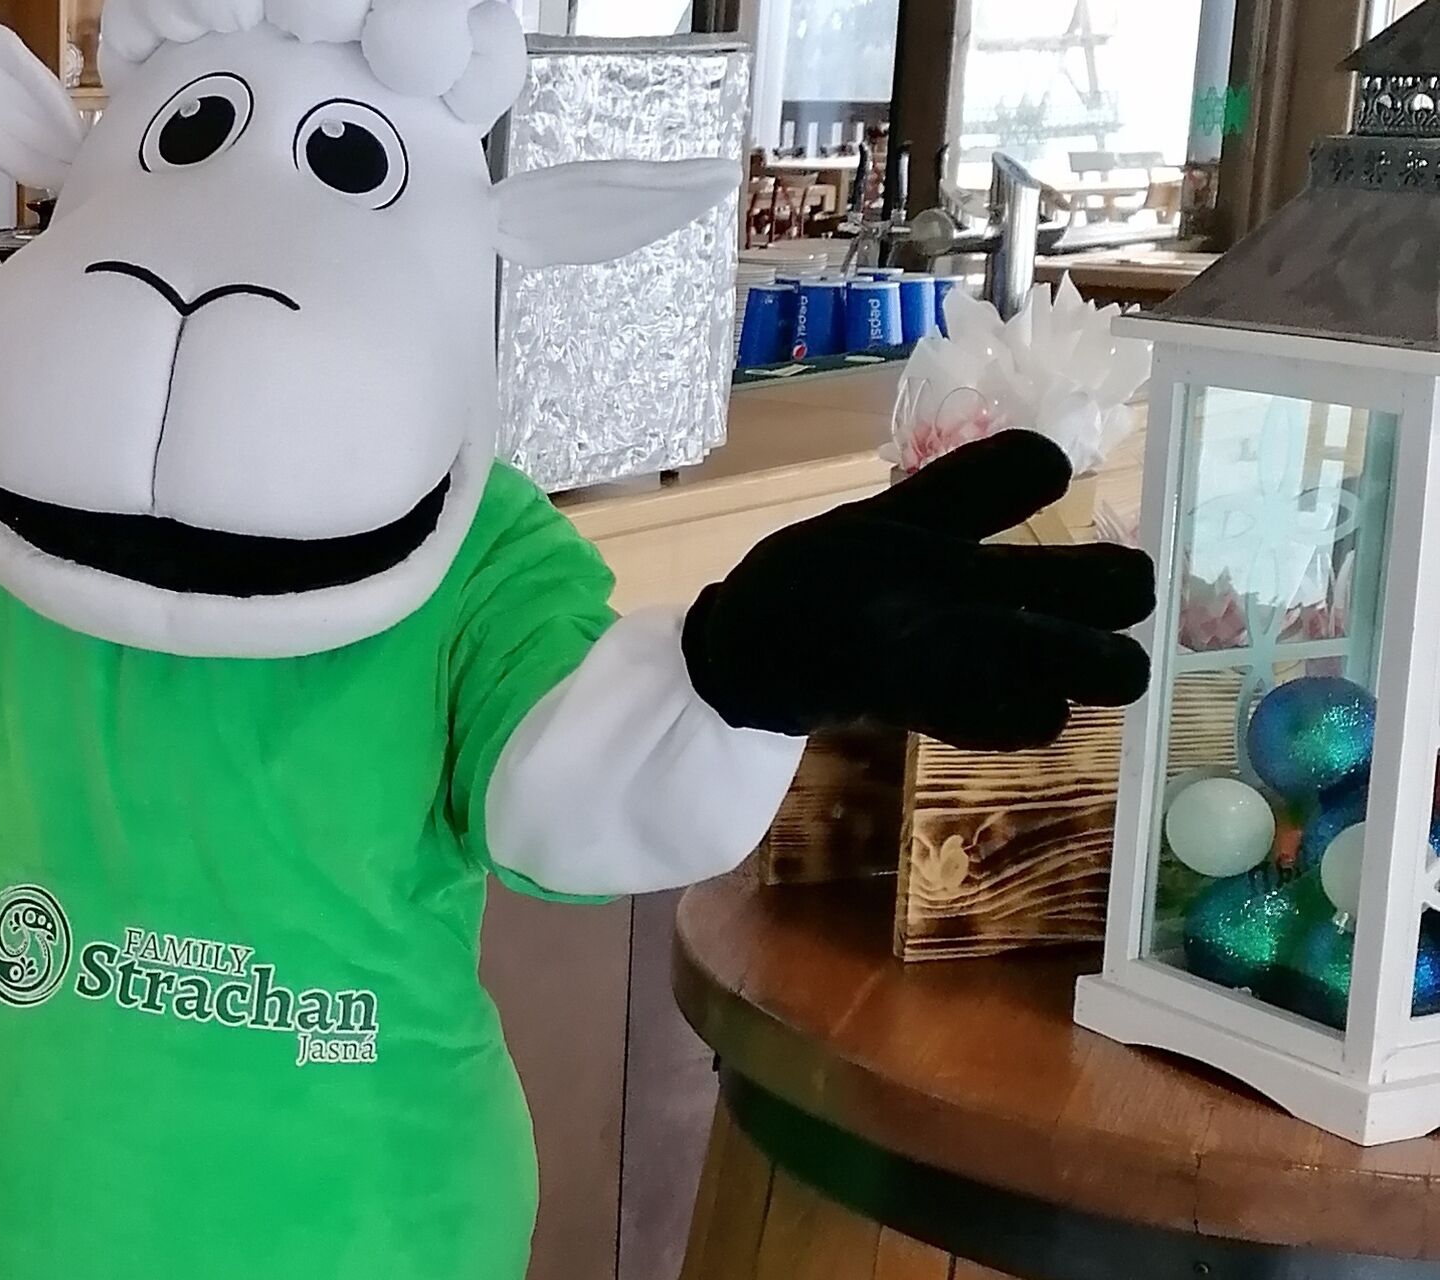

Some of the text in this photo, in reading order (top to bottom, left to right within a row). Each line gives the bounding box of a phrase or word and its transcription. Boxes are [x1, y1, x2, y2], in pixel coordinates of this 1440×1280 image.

[868, 298, 883, 340] pepsi
[122, 927, 255, 977] FAMILY
[74, 940, 380, 1034] Strachan
[296, 1031, 378, 1067] Jasná
